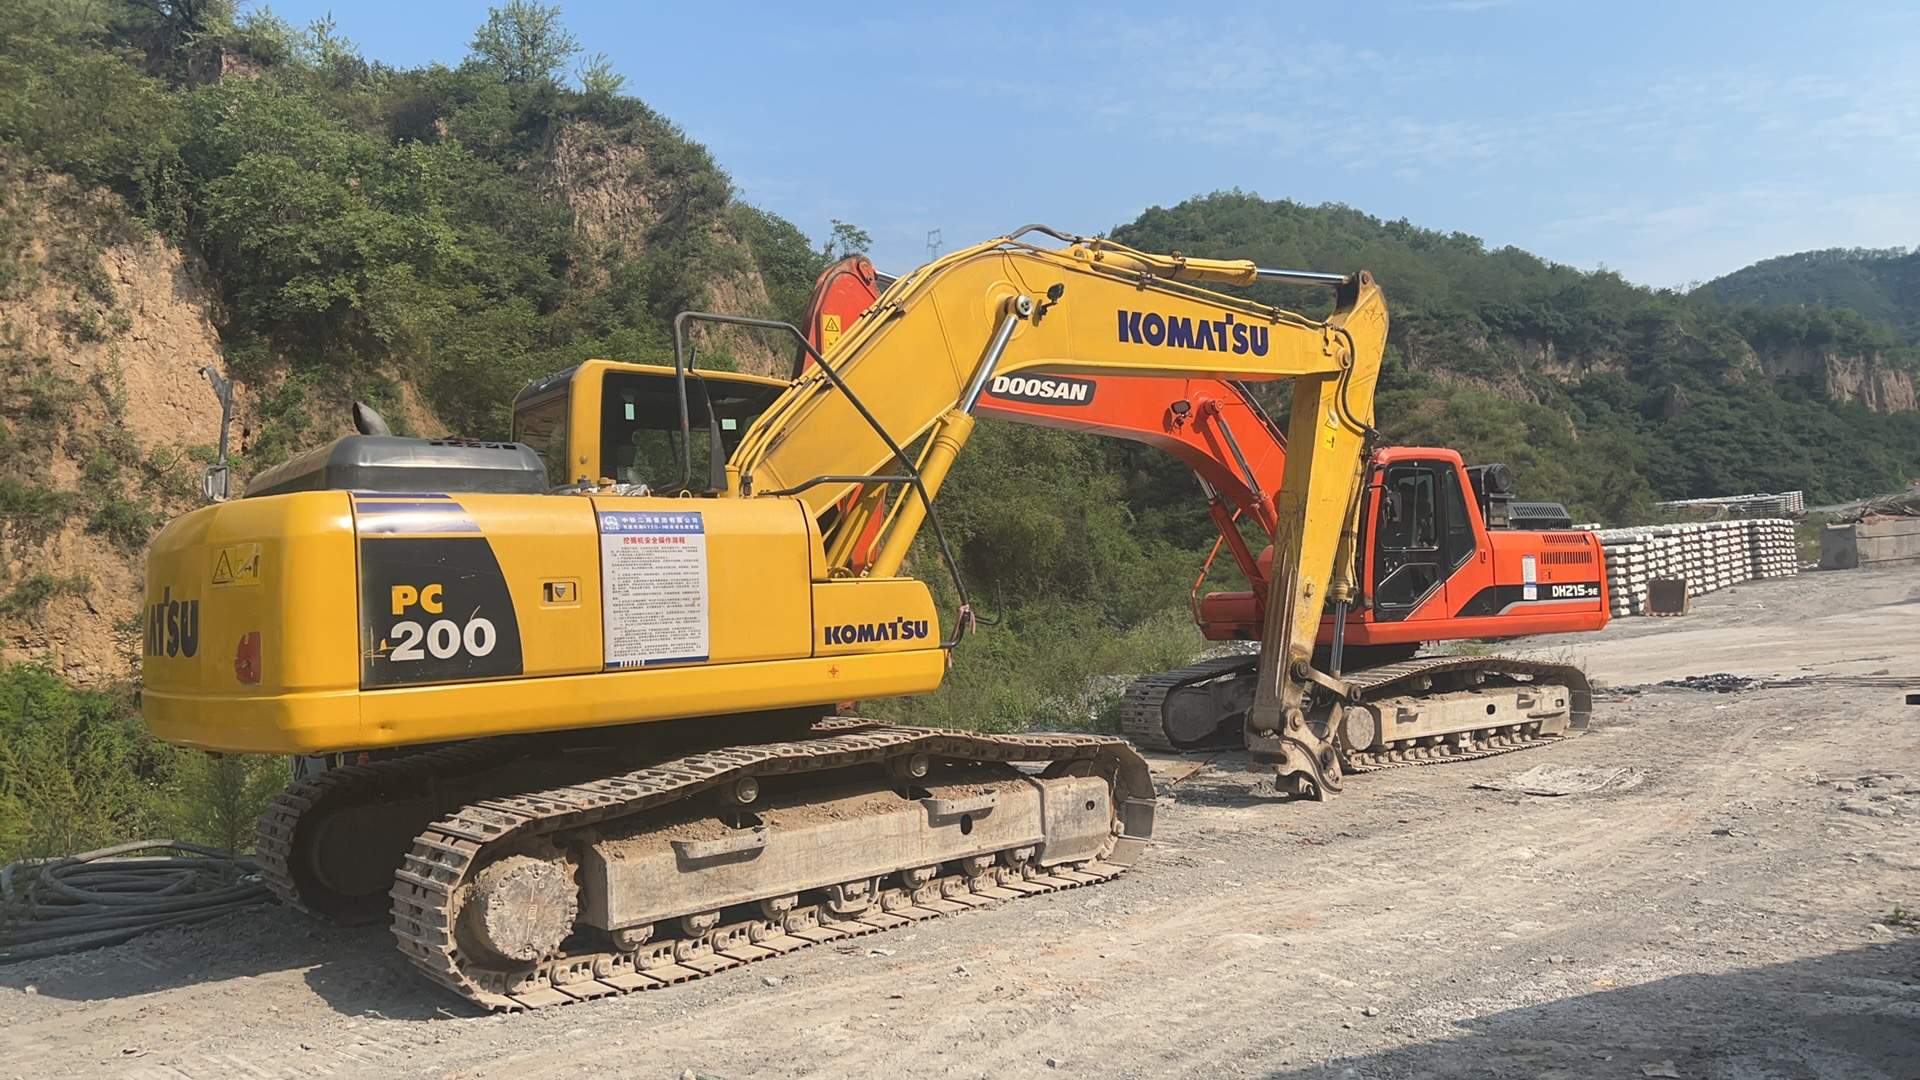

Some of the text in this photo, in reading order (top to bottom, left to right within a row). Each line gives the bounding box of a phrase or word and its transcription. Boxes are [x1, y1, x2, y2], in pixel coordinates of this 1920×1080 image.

[1117, 310, 1269, 356] KOMATSU
[991, 375, 1088, 401] DOOSAN
[391, 584, 443, 615] PC
[389, 618, 496, 661] 200
[824, 617, 928, 645] KOMATSU
